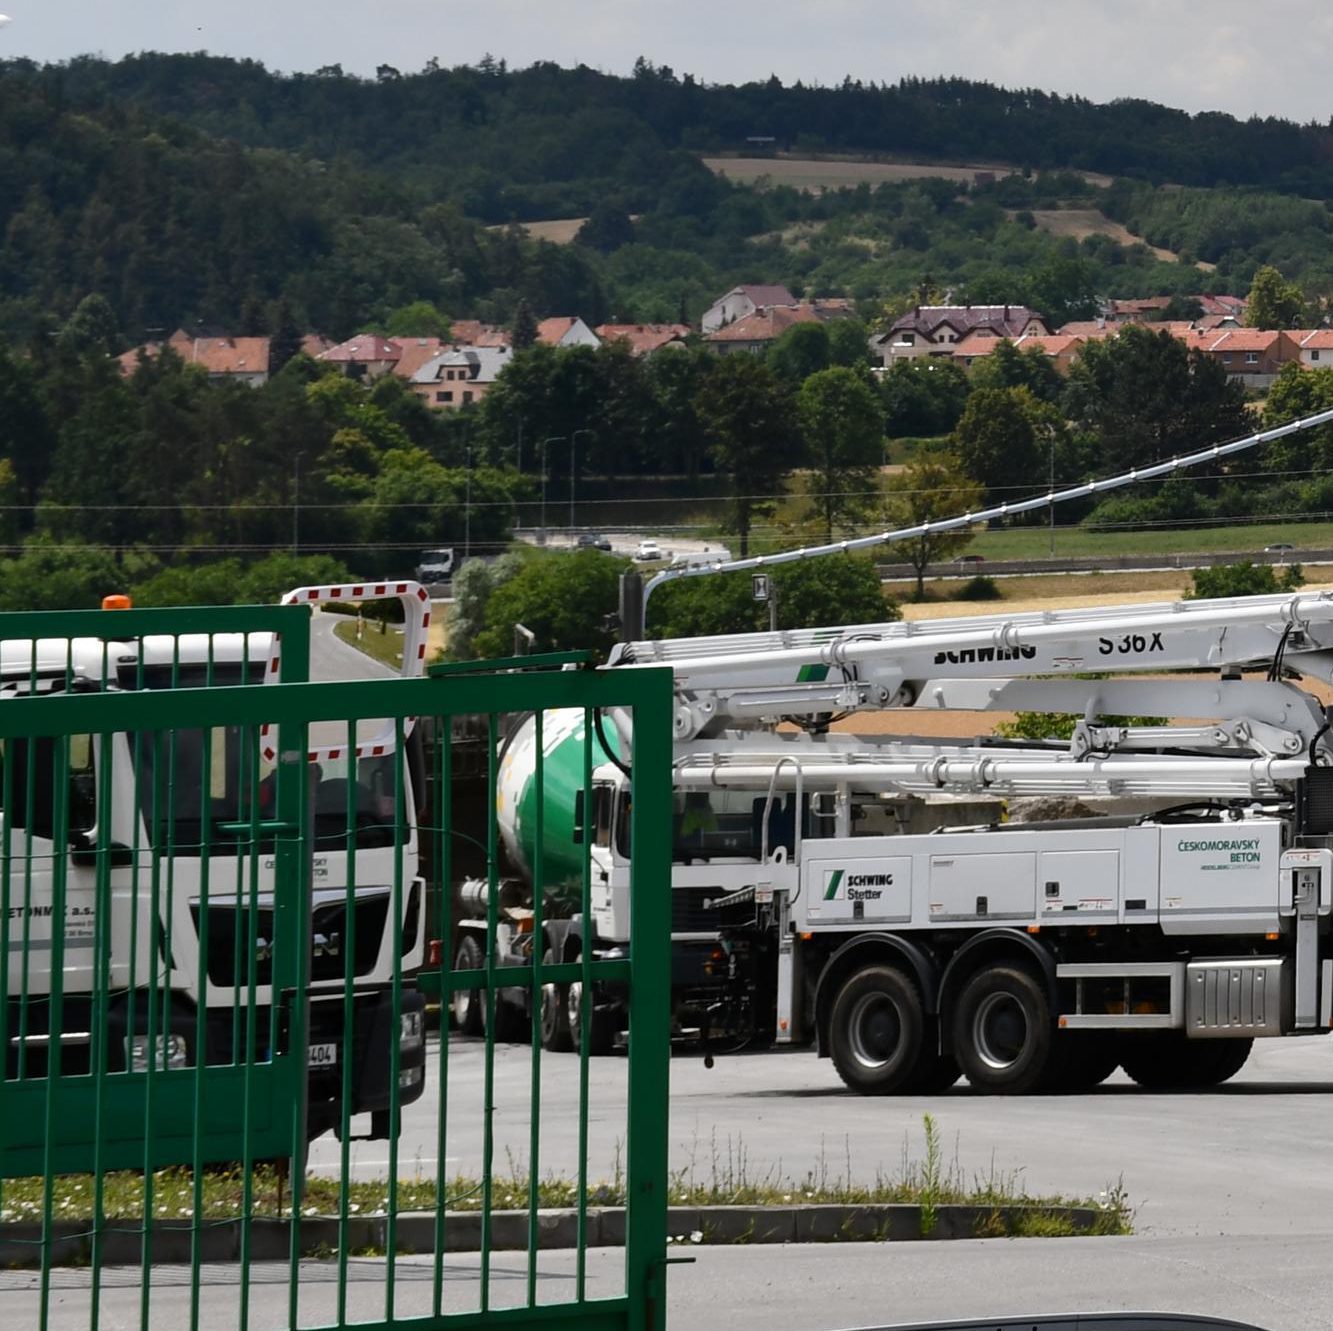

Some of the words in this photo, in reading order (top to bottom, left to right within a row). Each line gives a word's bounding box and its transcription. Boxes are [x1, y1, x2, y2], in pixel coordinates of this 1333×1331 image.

[1178, 838, 1260, 852] ČESKOMORAVSKÝ
[1230, 852, 1260, 863] BETON
[848, 874, 893, 886] SCHWING
[848, 888, 882, 900] Stetter
[255, 932, 339, 961] MN
